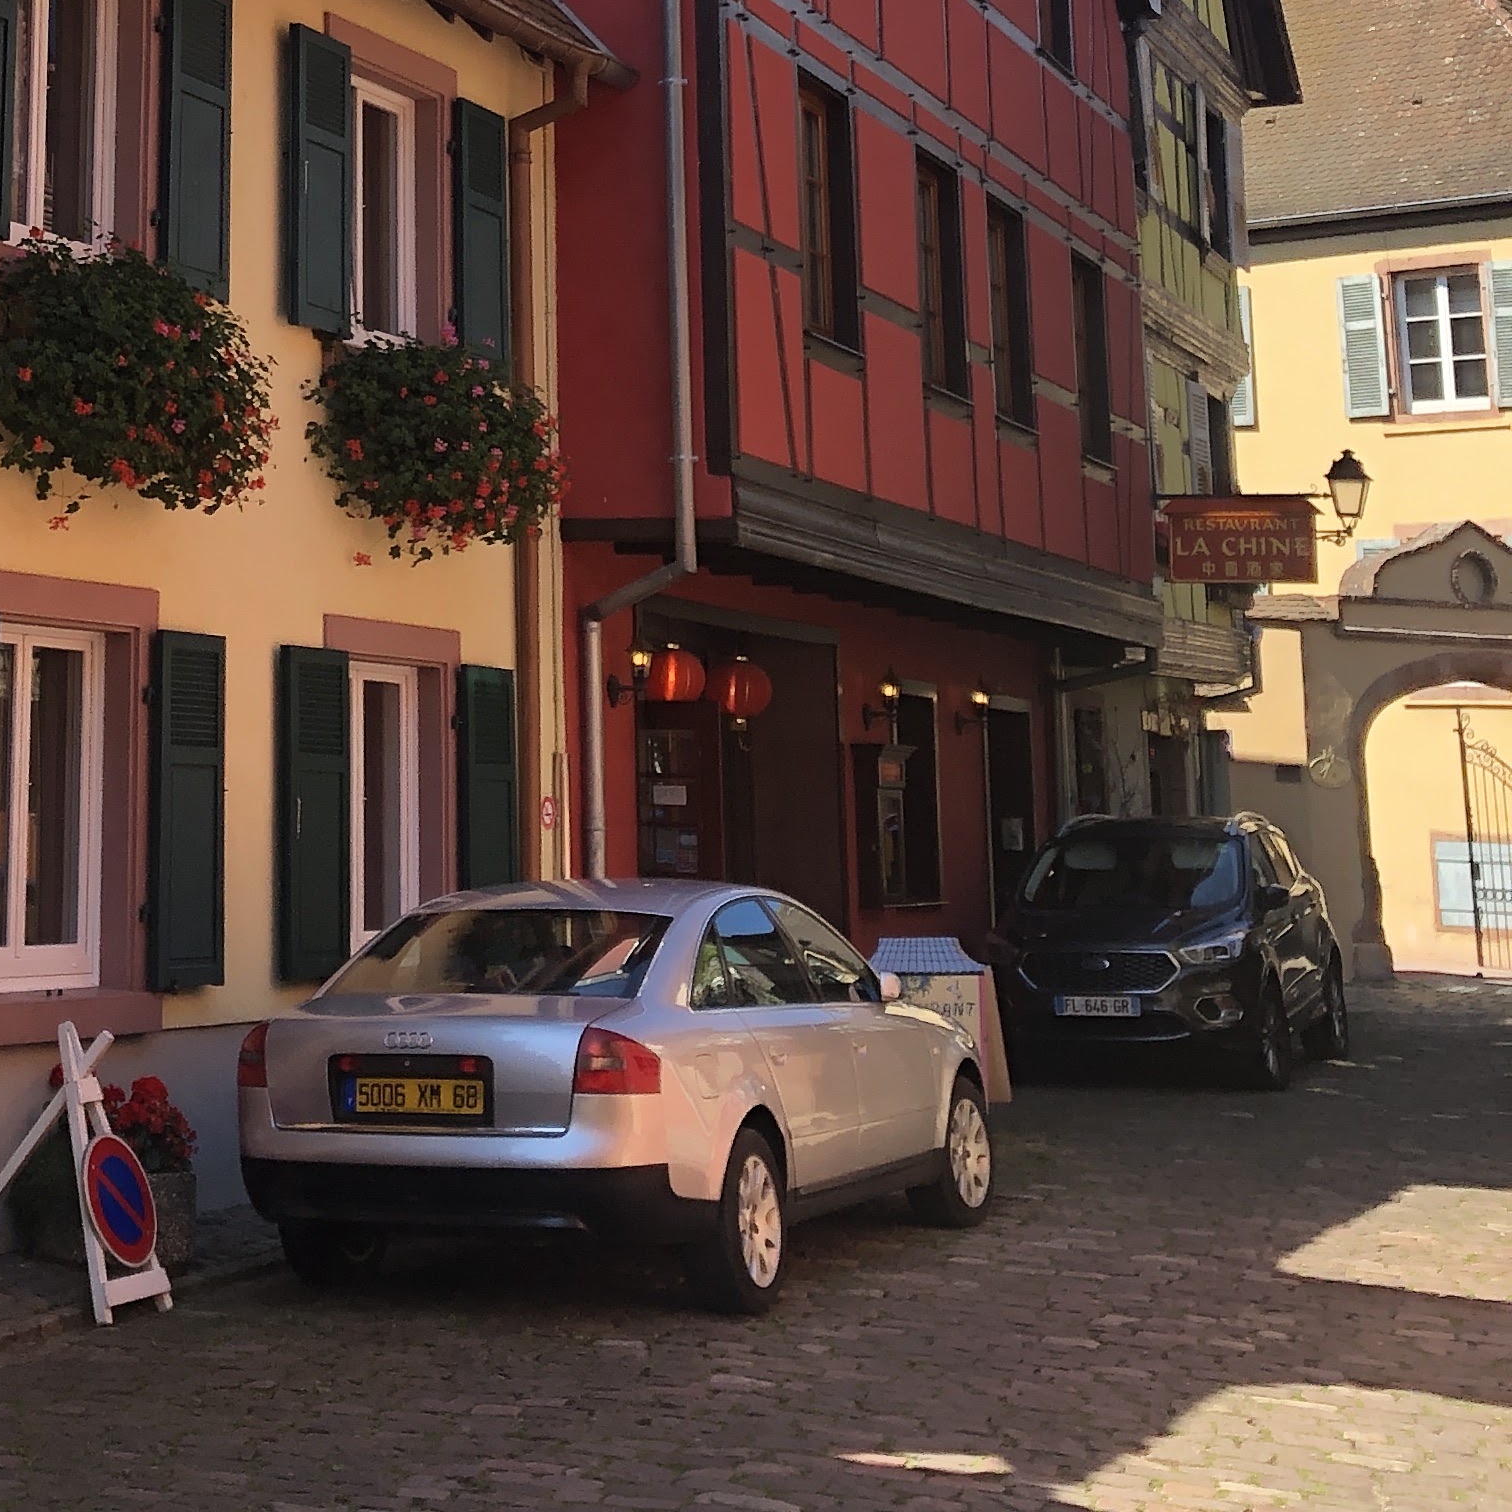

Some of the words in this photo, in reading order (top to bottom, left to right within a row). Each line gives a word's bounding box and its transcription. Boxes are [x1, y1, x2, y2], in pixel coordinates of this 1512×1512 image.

[1175, 536, 1211, 556] LA
[1221, 536, 1311, 557] CHINE
[1064, 998, 1080, 1013] FL
[1084, 998, 1108, 1014] 646
[1113, 999, 1130, 1014] GR
[358, 1082, 406, 1107] 5006
[417, 1083, 442, 1108] XM
[452, 1084, 478, 1109] 68
